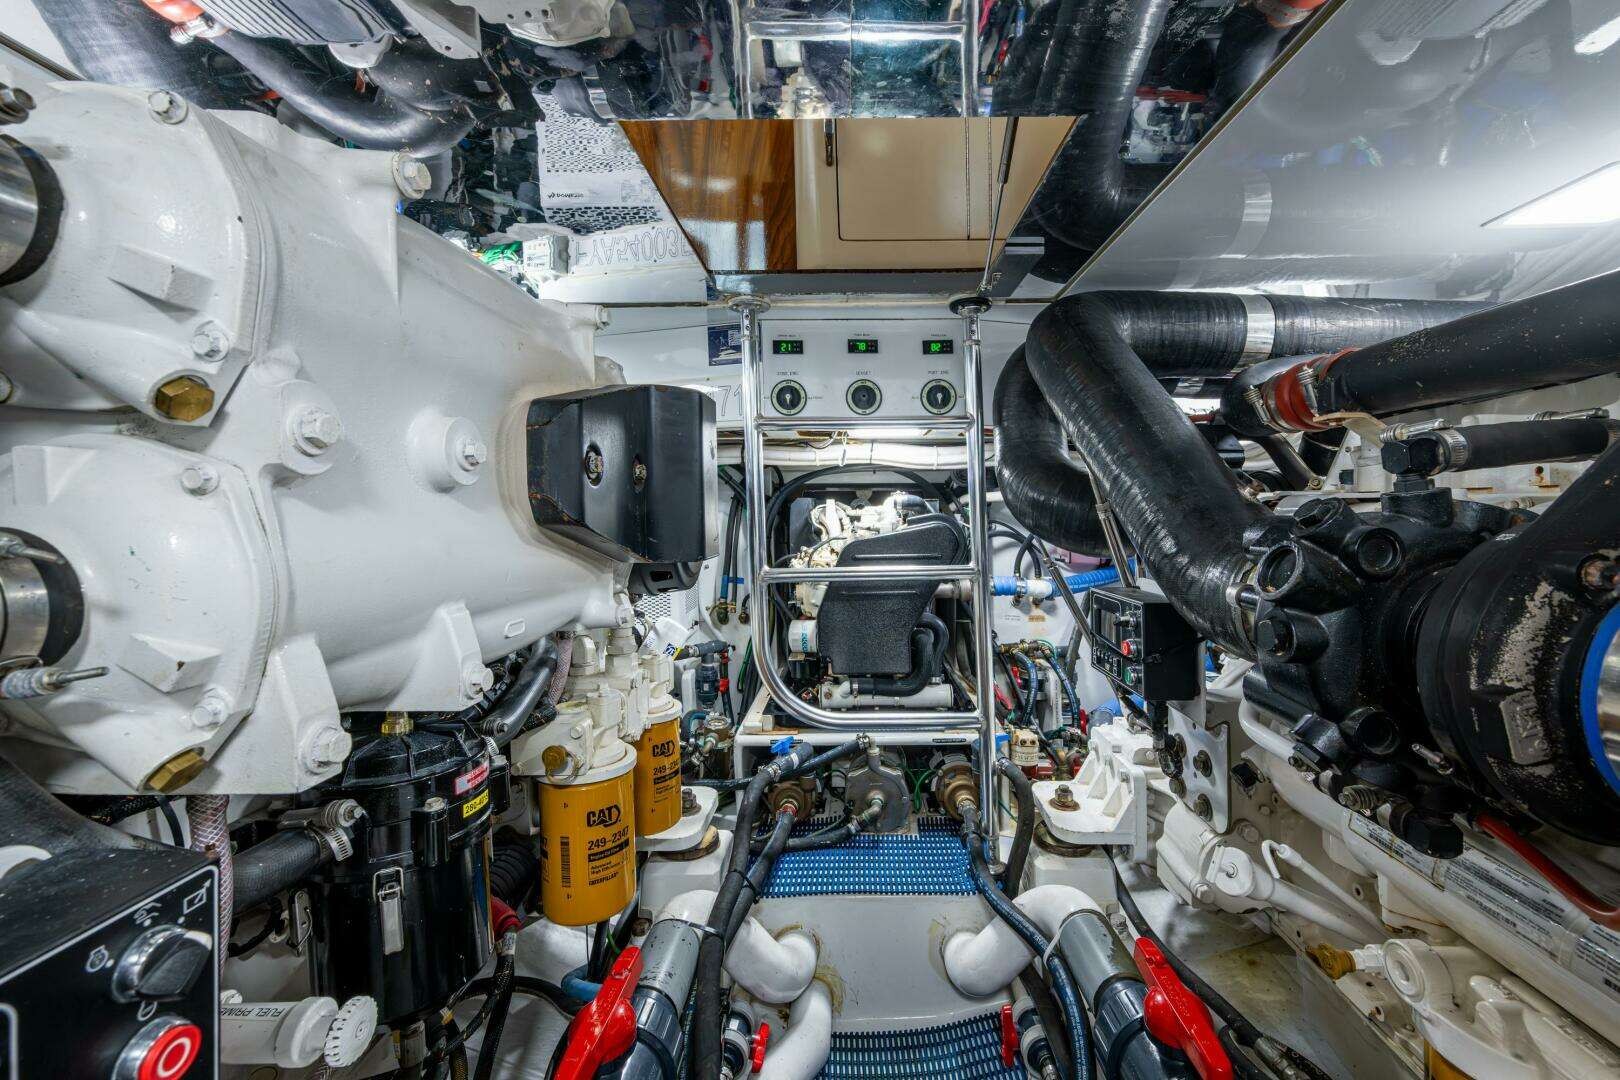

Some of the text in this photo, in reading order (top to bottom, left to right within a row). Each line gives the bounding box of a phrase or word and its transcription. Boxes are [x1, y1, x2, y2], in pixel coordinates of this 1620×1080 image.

[856, 342, 866, 350] 78
[652, 740, 675, 757] CAT
[586, 804, 621, 828] CAT
[587, 826, 629, 851] 249-2347
[256, 1007, 285, 1017] FUEL
